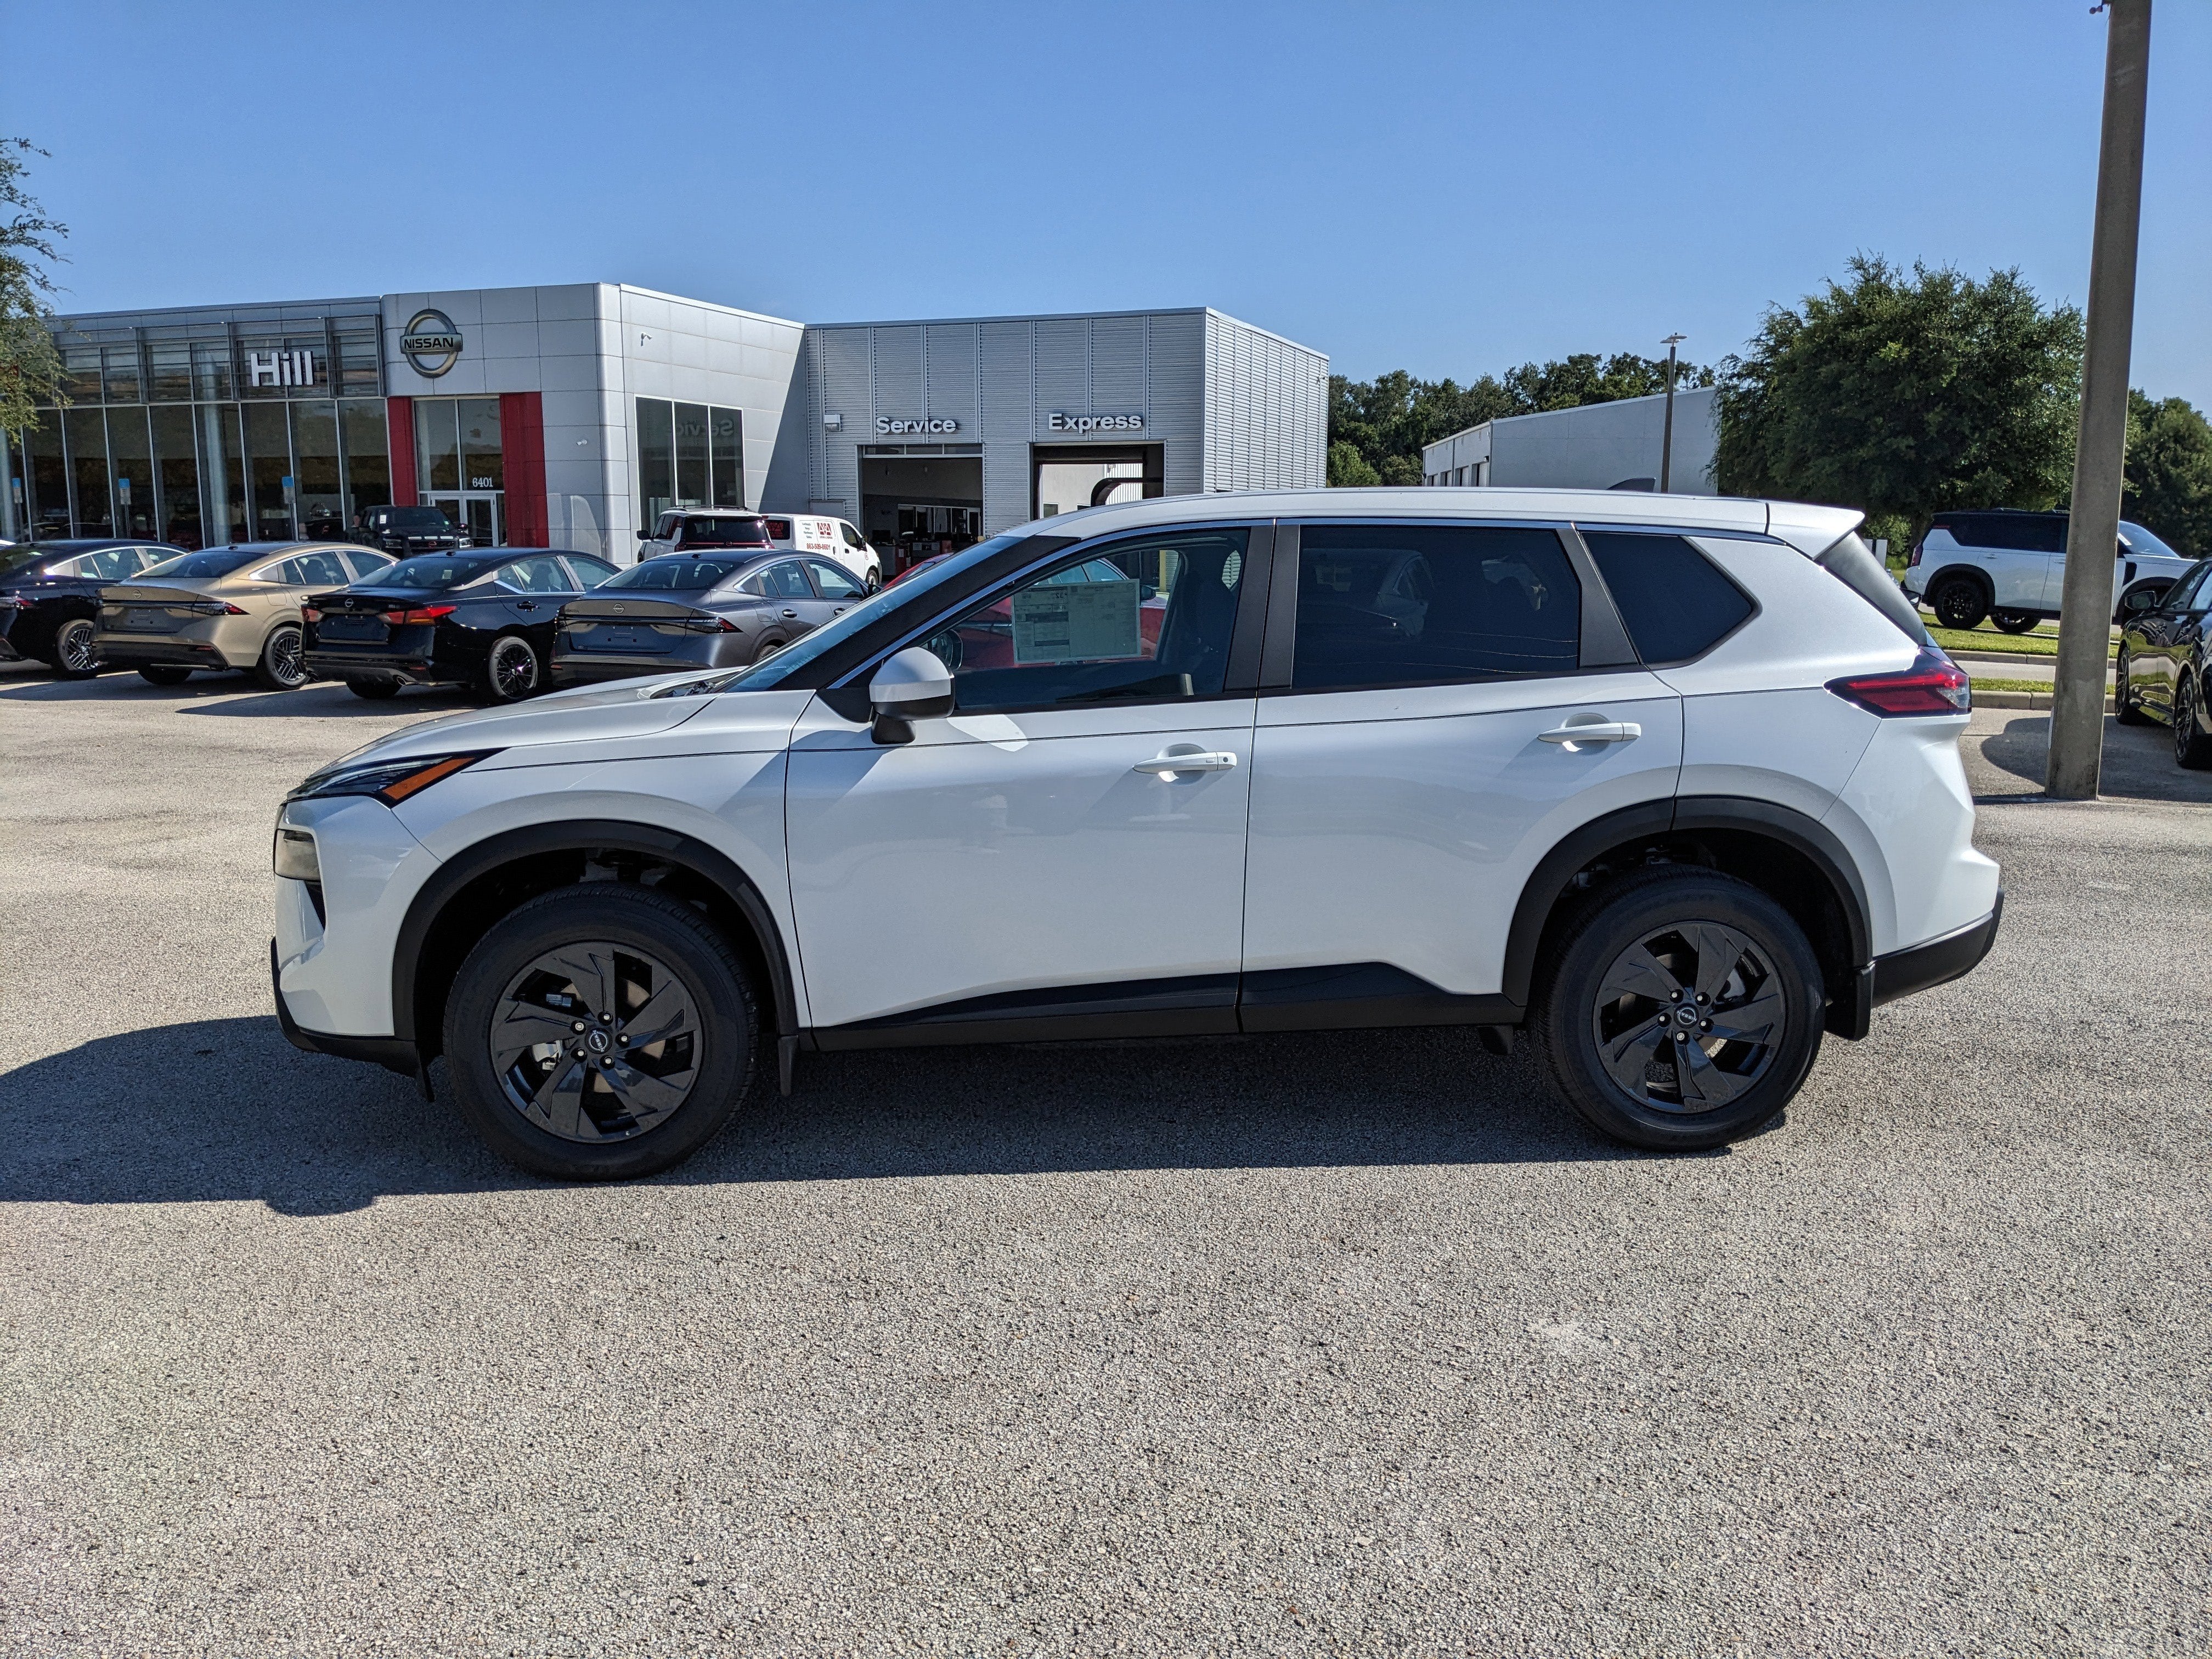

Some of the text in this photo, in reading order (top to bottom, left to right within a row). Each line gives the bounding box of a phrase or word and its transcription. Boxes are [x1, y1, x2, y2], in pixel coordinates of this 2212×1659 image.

[404, 337, 454, 348] NISSAN
[251, 351, 313, 387] Hill
[876, 417, 956, 433] Service
[1048, 413, 1142, 434] Express
[472, 477, 493, 488] 6401
[1677, 1010, 1697, 1022] NISSAN
[592, 1030, 605, 1052] NISSAN
